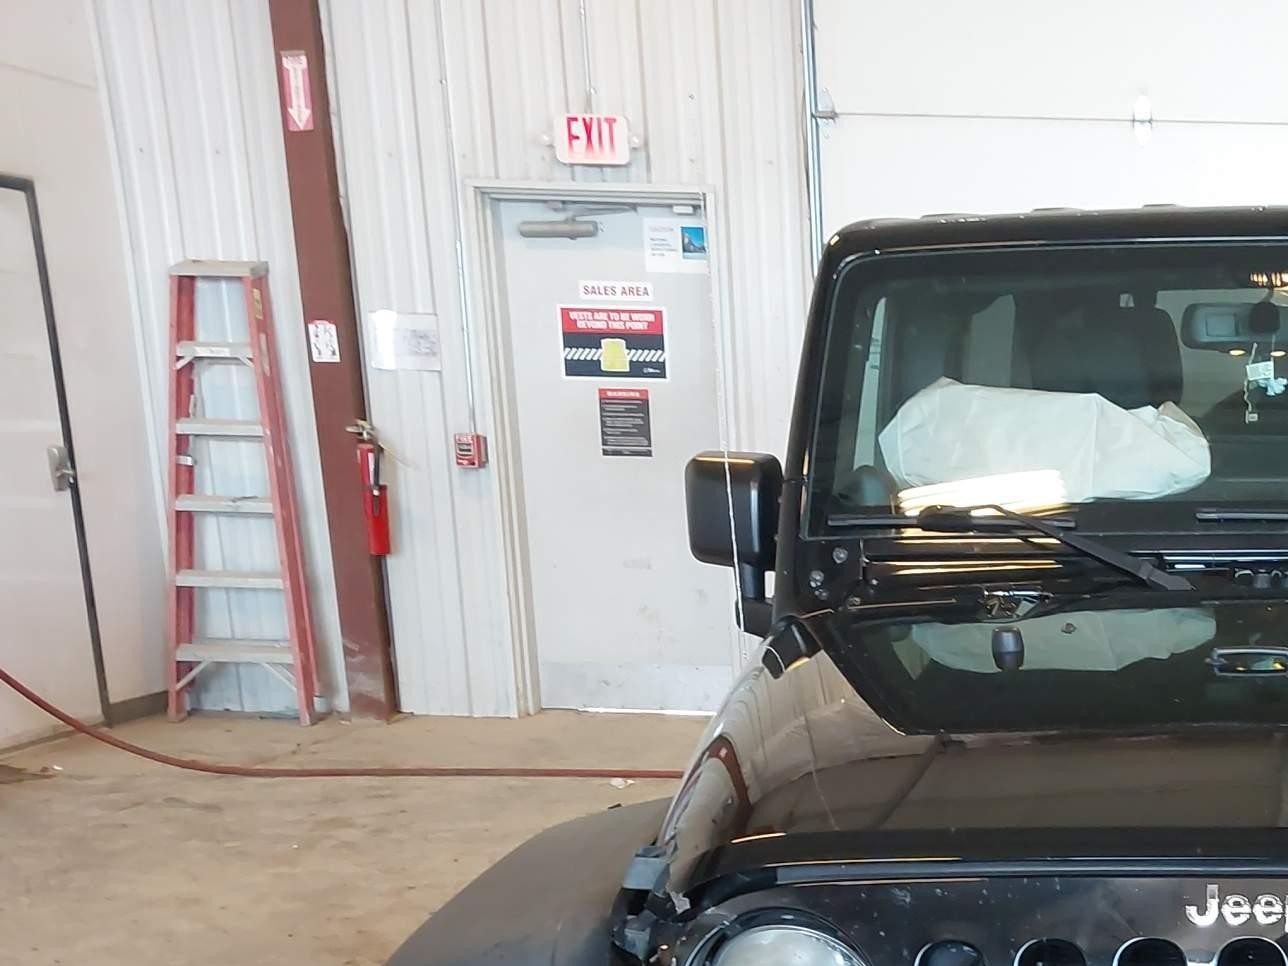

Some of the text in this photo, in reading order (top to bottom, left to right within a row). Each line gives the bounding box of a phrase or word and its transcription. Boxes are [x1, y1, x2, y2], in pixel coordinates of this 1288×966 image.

[565, 116, 617, 159] EXIT
[583, 285, 650, 297] SALES AREA
